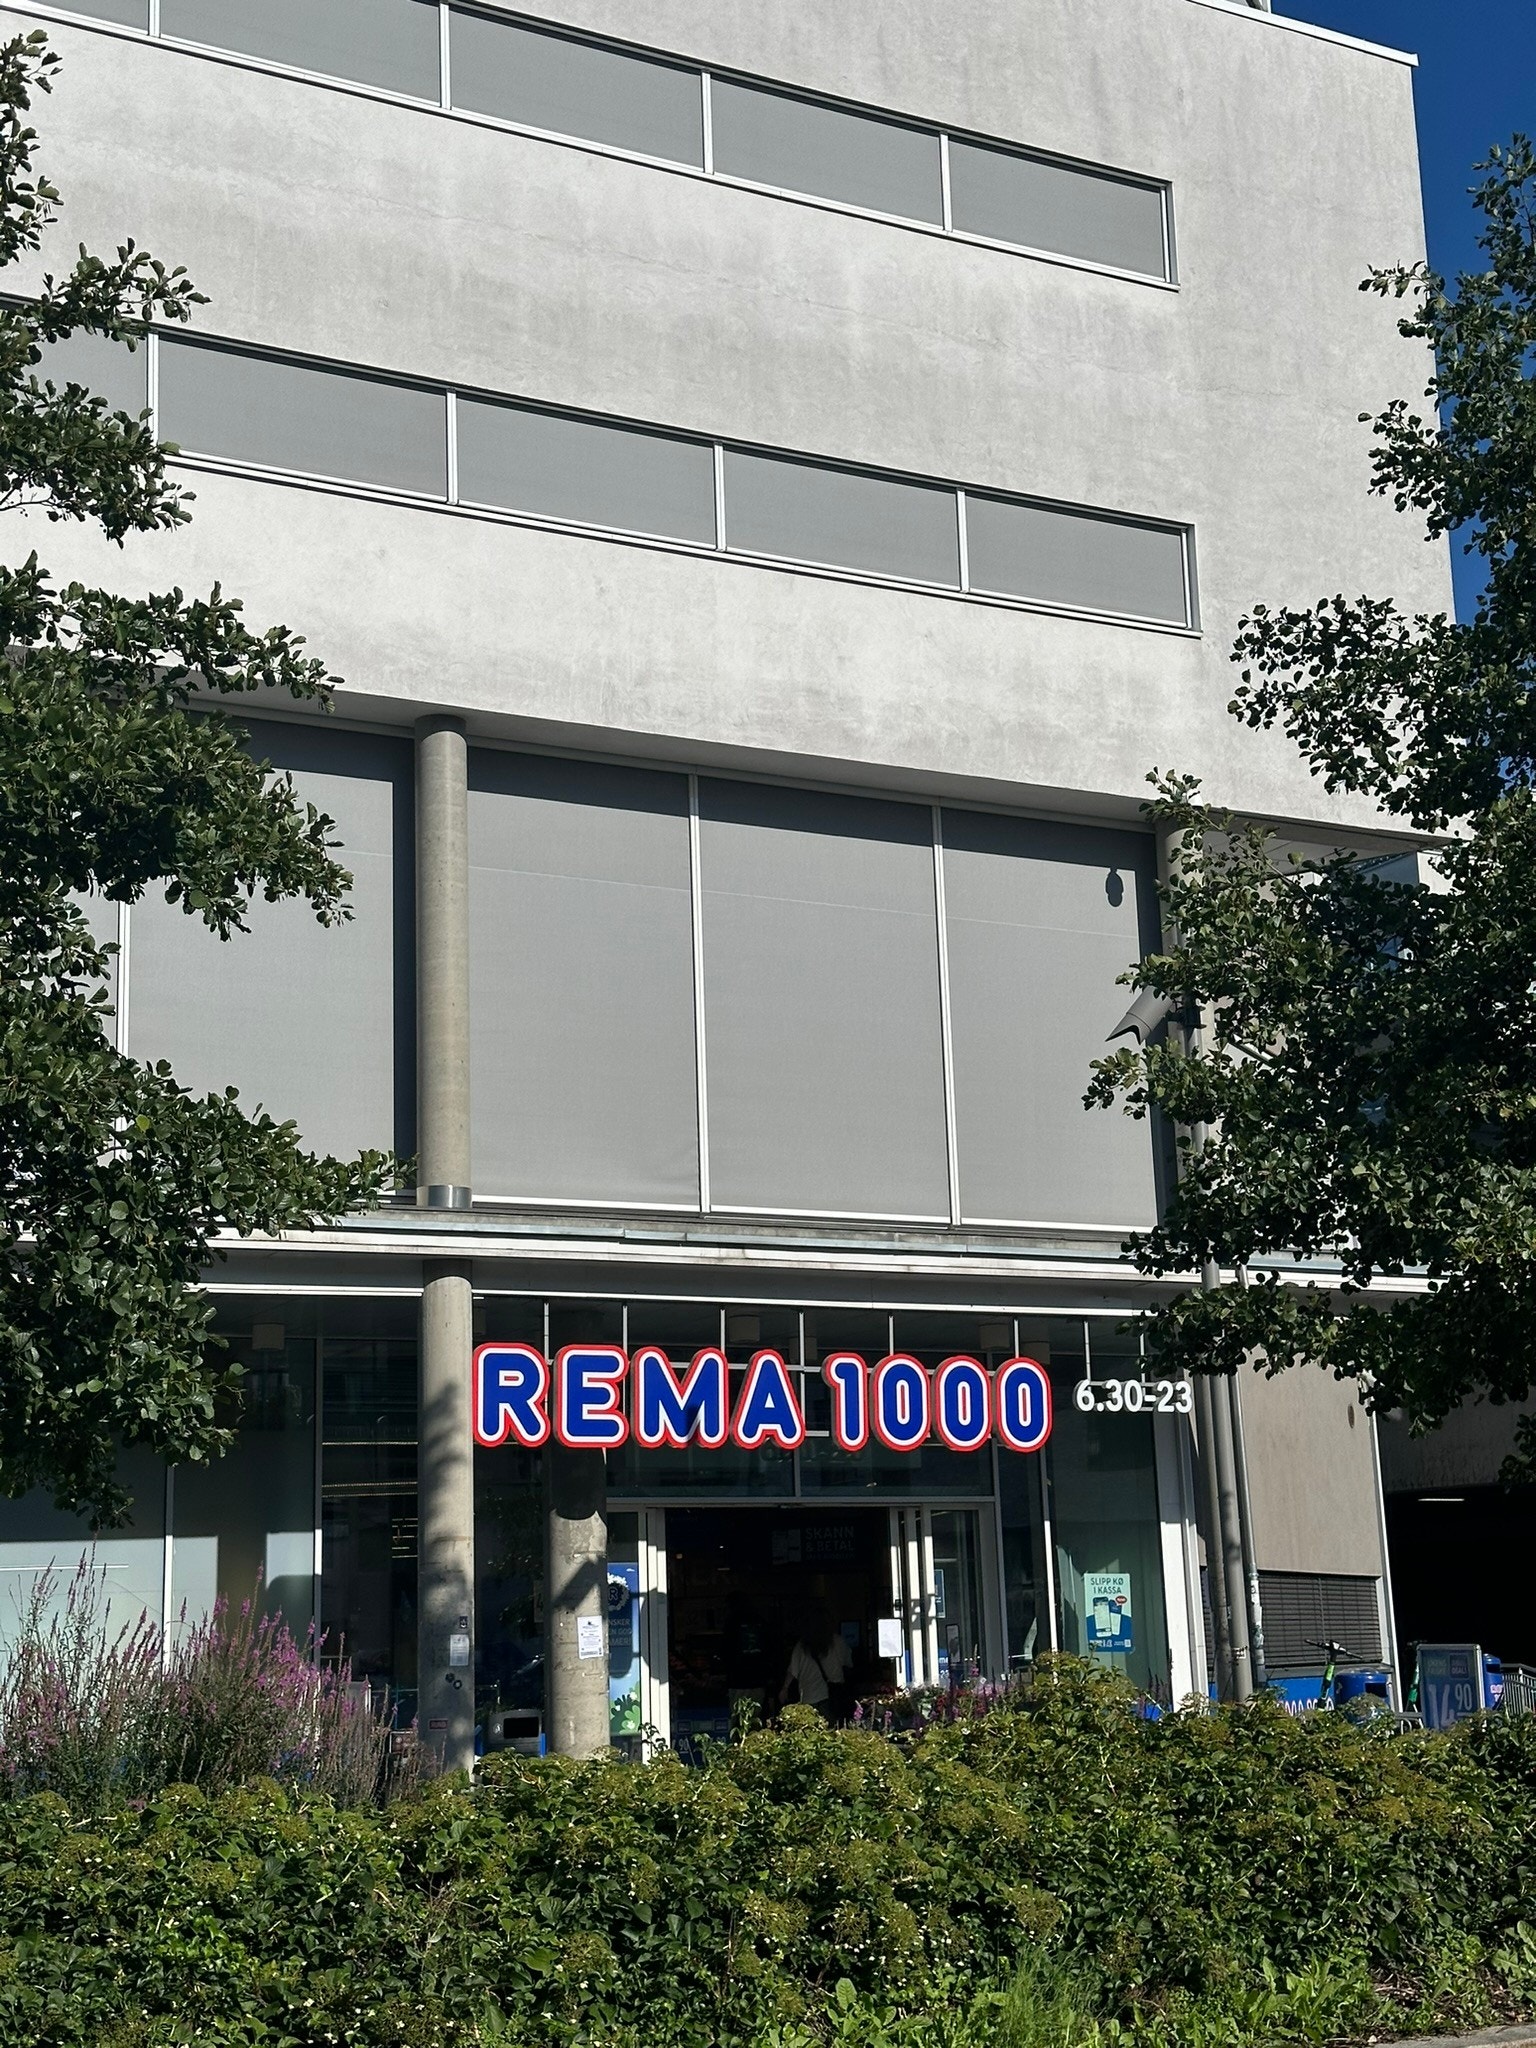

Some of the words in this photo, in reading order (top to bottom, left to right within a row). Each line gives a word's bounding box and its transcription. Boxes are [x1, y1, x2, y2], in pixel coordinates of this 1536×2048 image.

[472, 1342, 806, 1450] REMA
[821, 1352, 1052, 1452] 1000
[1073, 1378, 1193, 1413] 6.30-23
[1090, 1577, 1112, 1586] SLIPP
[1097, 1586, 1122, 1595] KASSA
